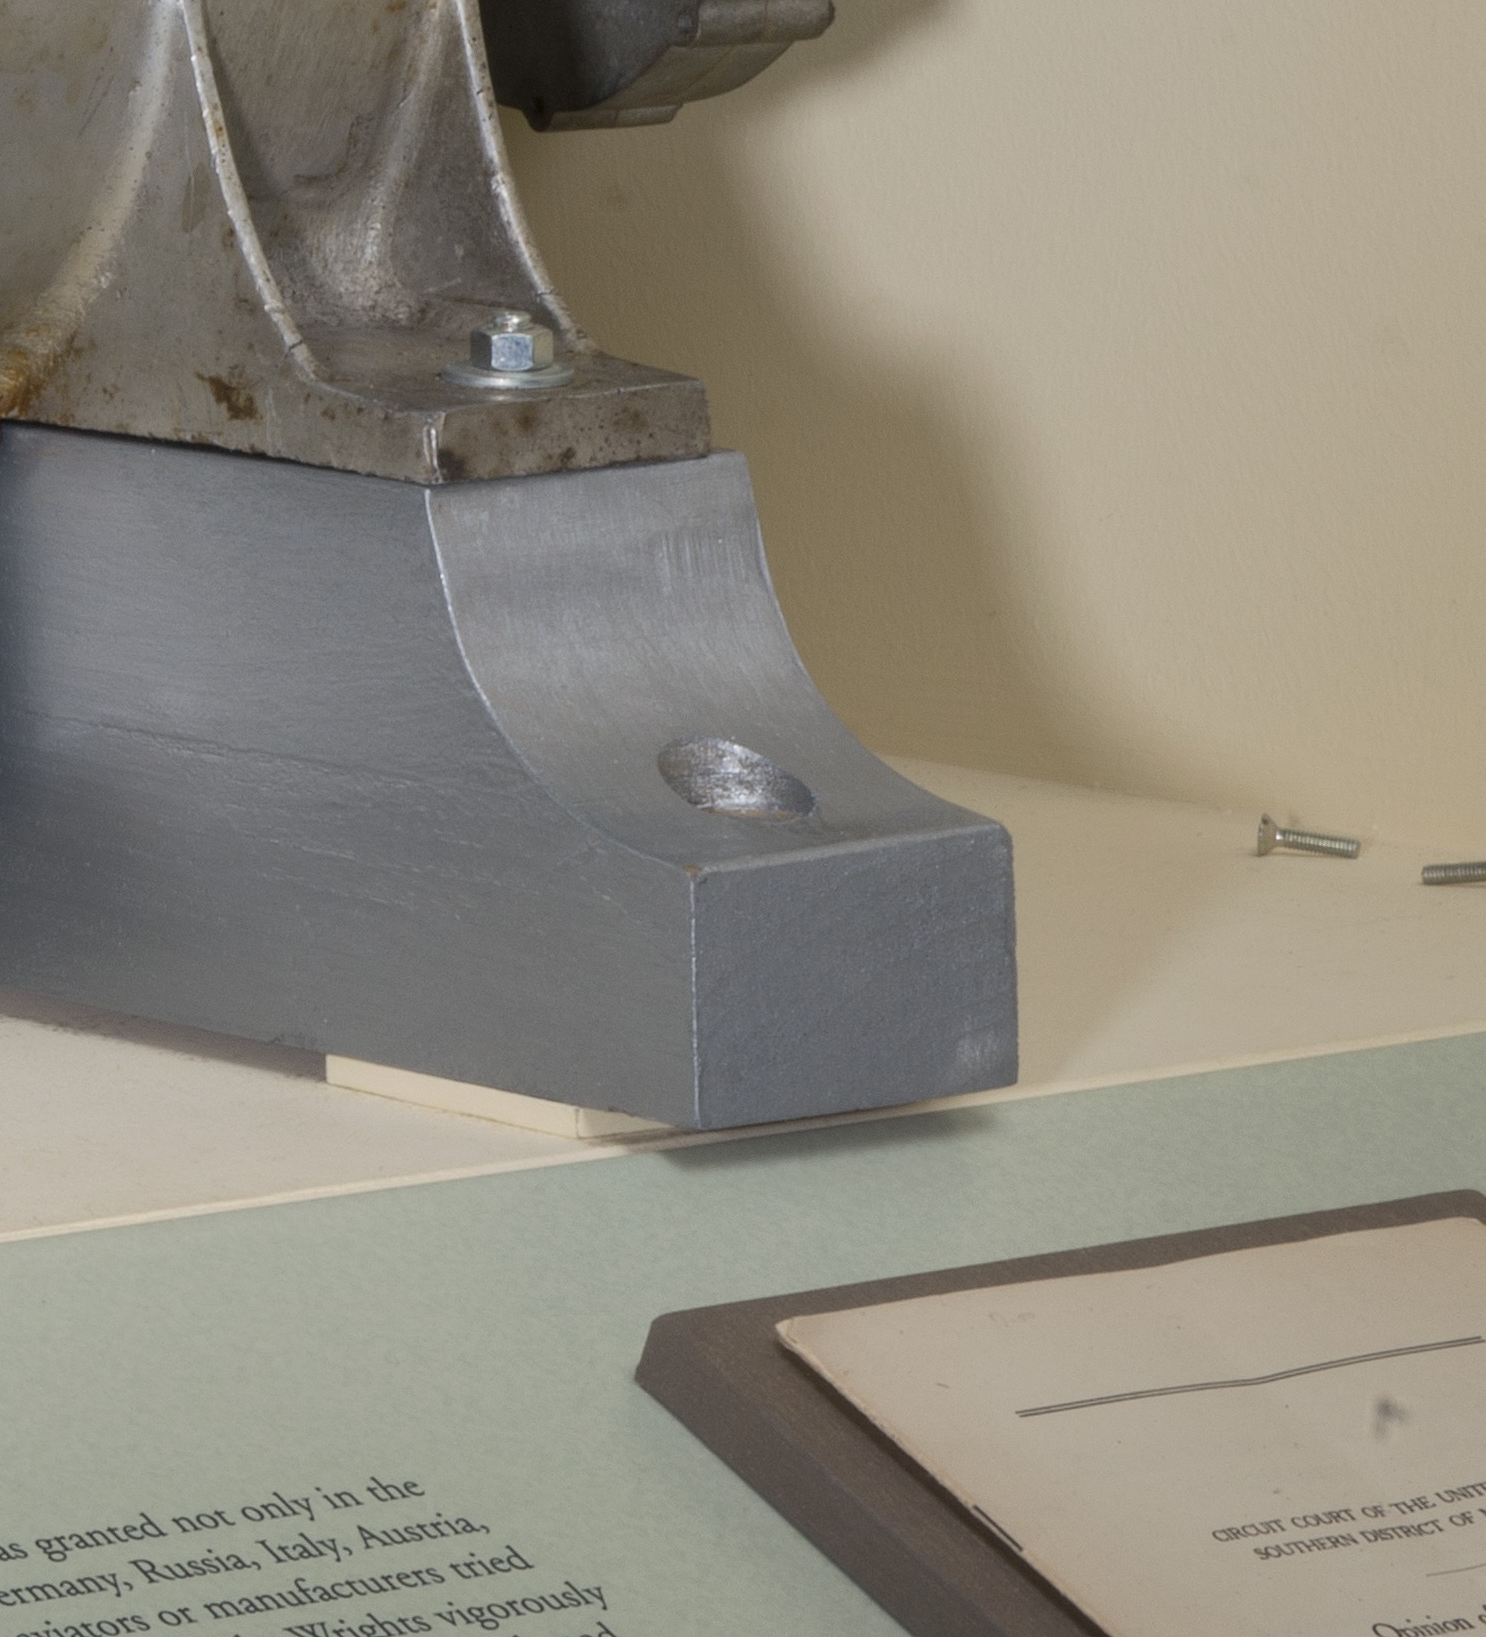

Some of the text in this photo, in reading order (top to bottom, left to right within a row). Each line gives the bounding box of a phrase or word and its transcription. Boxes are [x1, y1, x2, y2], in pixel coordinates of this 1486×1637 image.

[35, 1512, 168, 1562] granted
[172, 1510, 236, 1533] not
[241, 1492, 315, 1522] only
[315, 1487, 363, 1509] in
[366, 1477, 425, 1502] the
[128, 1549, 261, 1584] Russia,
[251, 1532, 353, 1570] Italy,
[357, 1513, 490, 1549] Austria,
[1212, 1519, 1286, 1542] CIRCUIT
[1291, 1509, 1356, 1528] COURT
[1361, 1505, 1385, 1518] OF
[1388, 1496, 1436, 1515] THE
[1253, 1511, 1474, 1560] SOUTHERN DISTRICT OF
[158, 1608, 197, 1626] or
[203, 1563, 445, 1619] manufacturers
[449, 1545, 534, 1579] tried
[434, 1581, 609, 1631] vigorously
